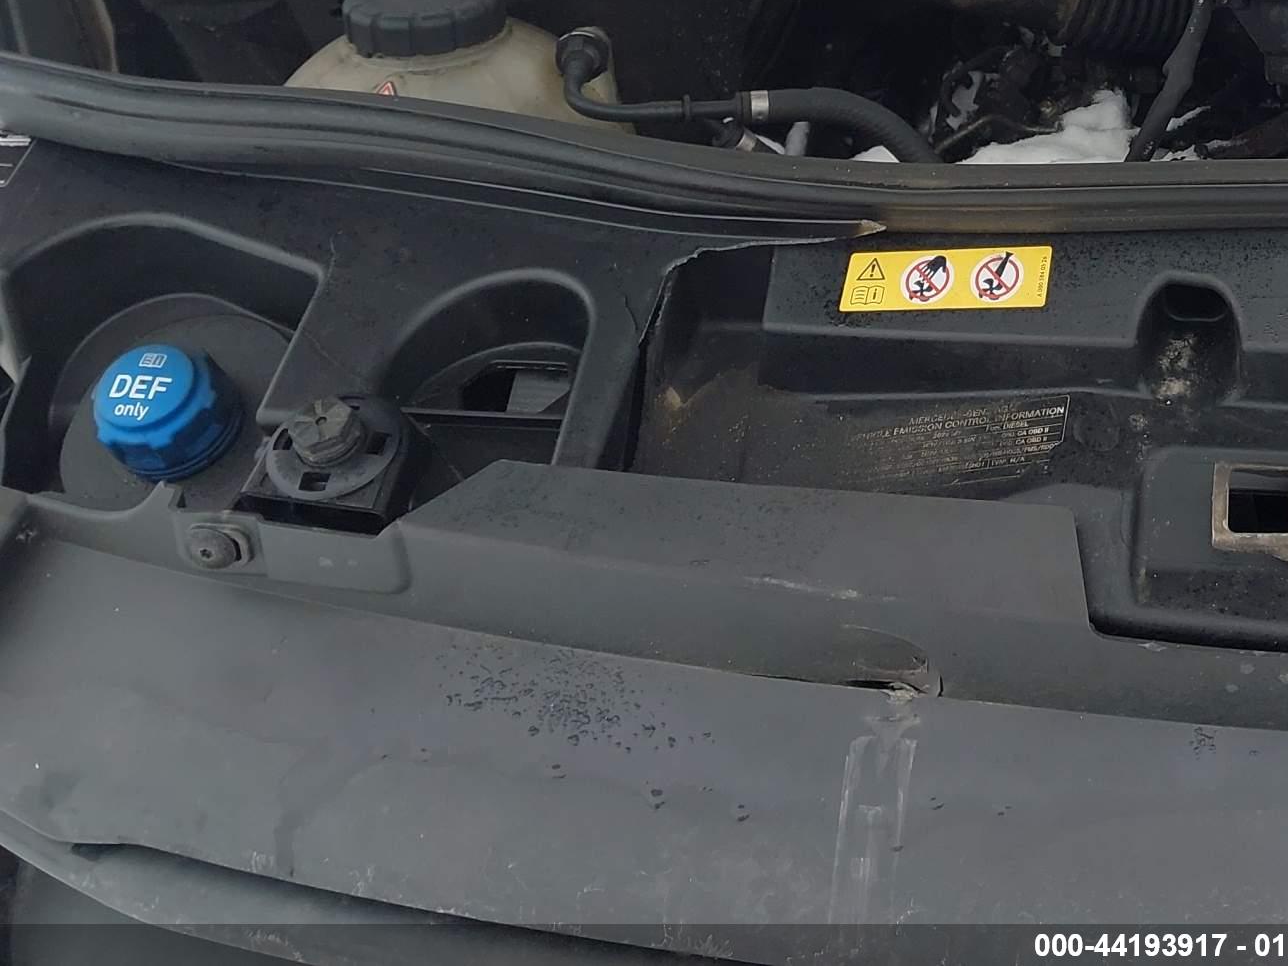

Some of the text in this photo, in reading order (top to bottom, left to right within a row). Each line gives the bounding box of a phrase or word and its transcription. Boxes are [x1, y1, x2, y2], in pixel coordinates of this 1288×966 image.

[108, 374, 173, 400] DEF
[114, 402, 150, 421] only
[893, 422, 942, 436] EMISSION
[994, 406, 1065, 423] INFORMATION
